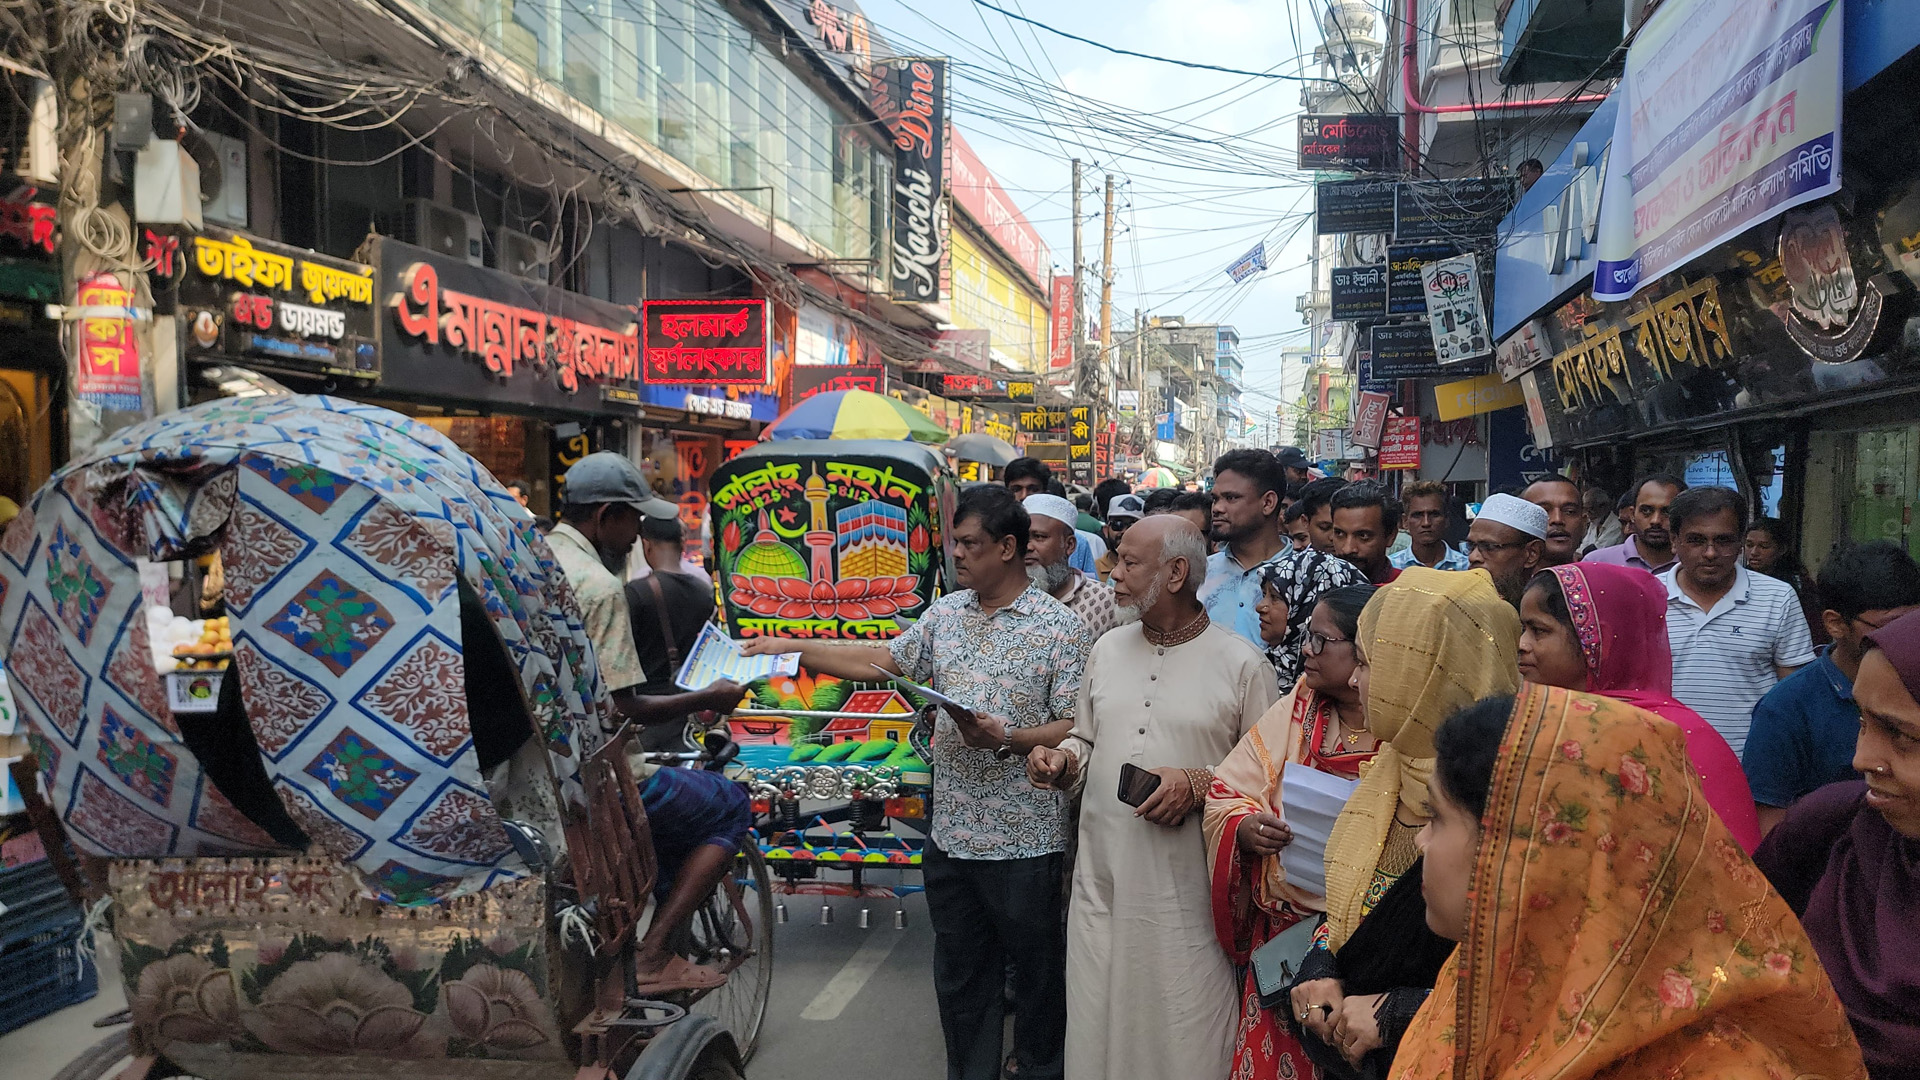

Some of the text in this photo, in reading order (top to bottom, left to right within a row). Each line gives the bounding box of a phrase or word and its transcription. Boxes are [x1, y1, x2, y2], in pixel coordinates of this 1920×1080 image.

[1699, 90, 1798, 192] অভিনন্দন
[1788, 144, 1831, 182] সমিতি
[892, 62, 943, 297] Kacchi Dine
[194, 234, 294, 292] তাইফা
[301, 260, 373, 304] জুয়েলার্স
[279, 301, 346, 340] ডায়মন্ড
[398, 262, 438, 345] এ
[442, 289, 547, 377] মান্নান
[660, 307, 749, 339] হলমার্ক
[1552, 274, 1735, 409] মোবাইল বাজার
[1020, 405, 1047, 430] লাকী
[713, 461, 805, 511] আল্লাহ
[826, 461, 923, 509] মহান
[737, 618, 839, 639] মায়ের
